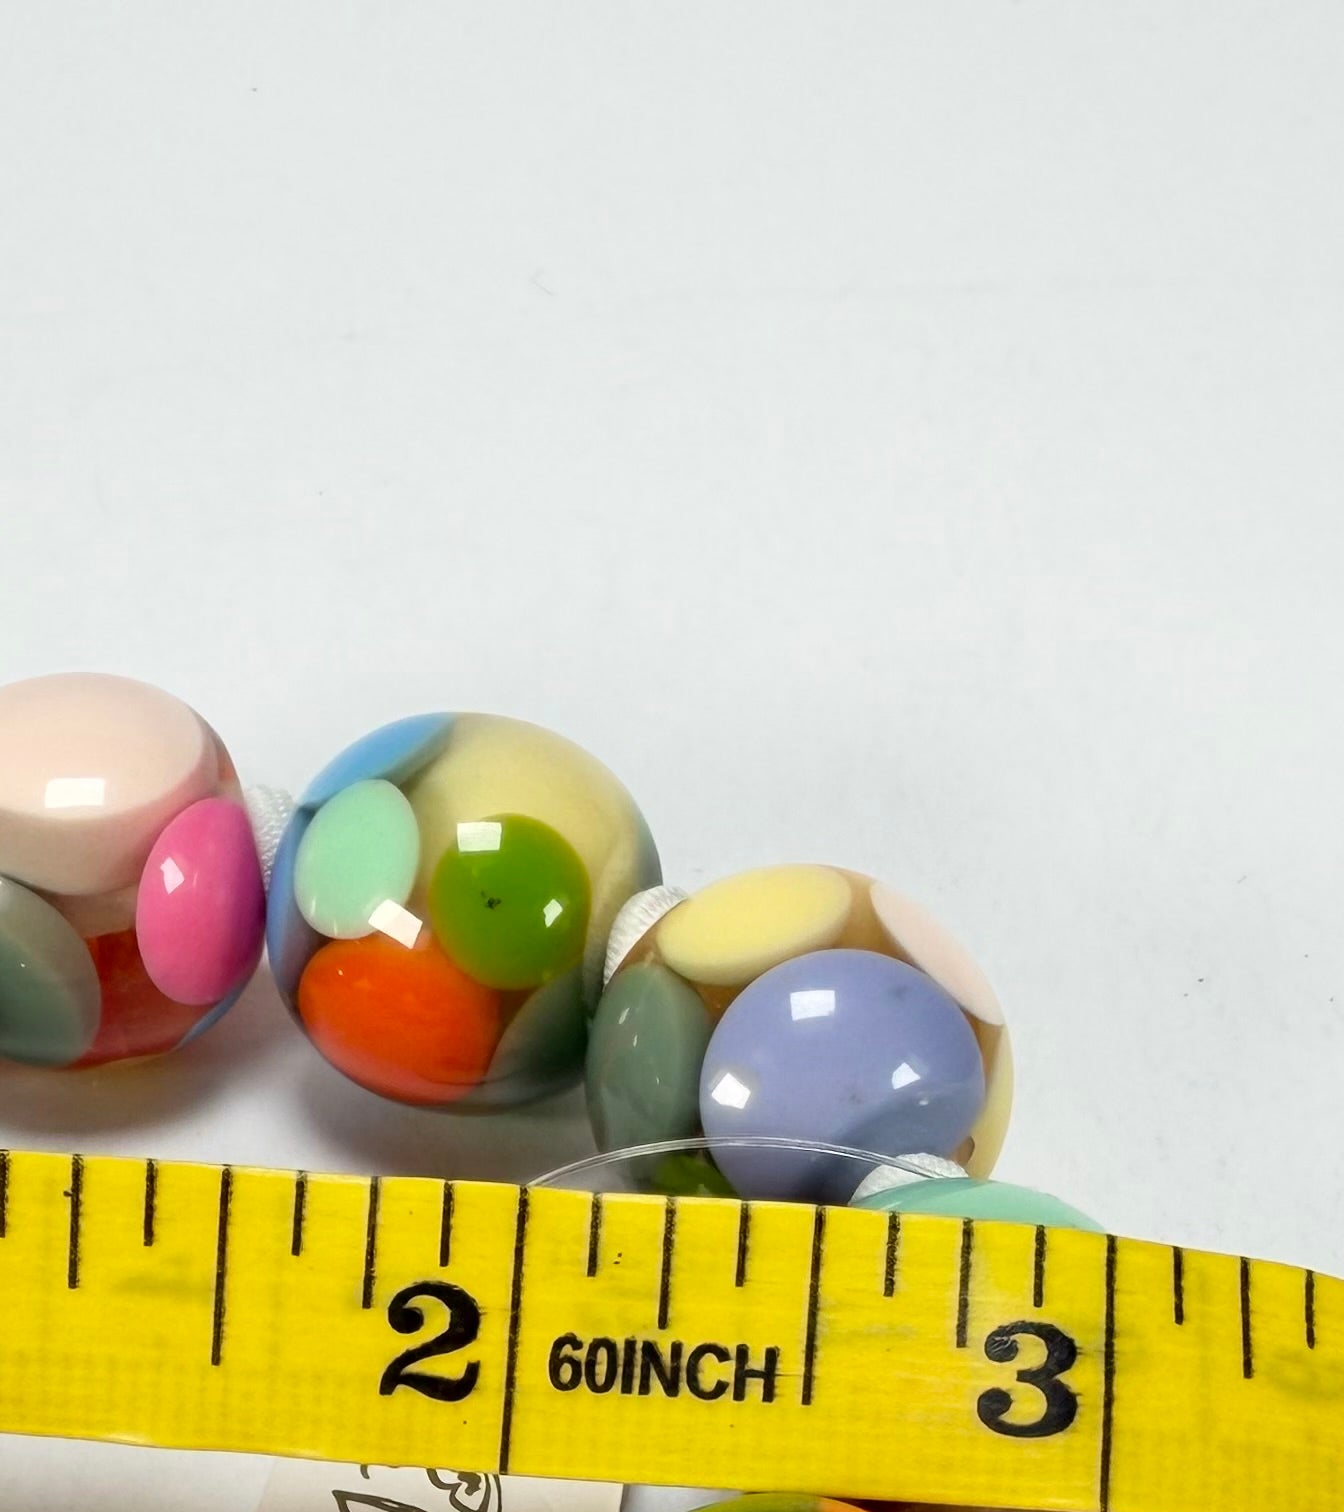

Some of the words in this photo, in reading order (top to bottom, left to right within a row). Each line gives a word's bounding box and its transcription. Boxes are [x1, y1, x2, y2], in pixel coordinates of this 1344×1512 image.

[378, 1280, 482, 1402] 2
[547, 1332, 781, 1404] 60INCH
[976, 1319, 1080, 1438] 3
